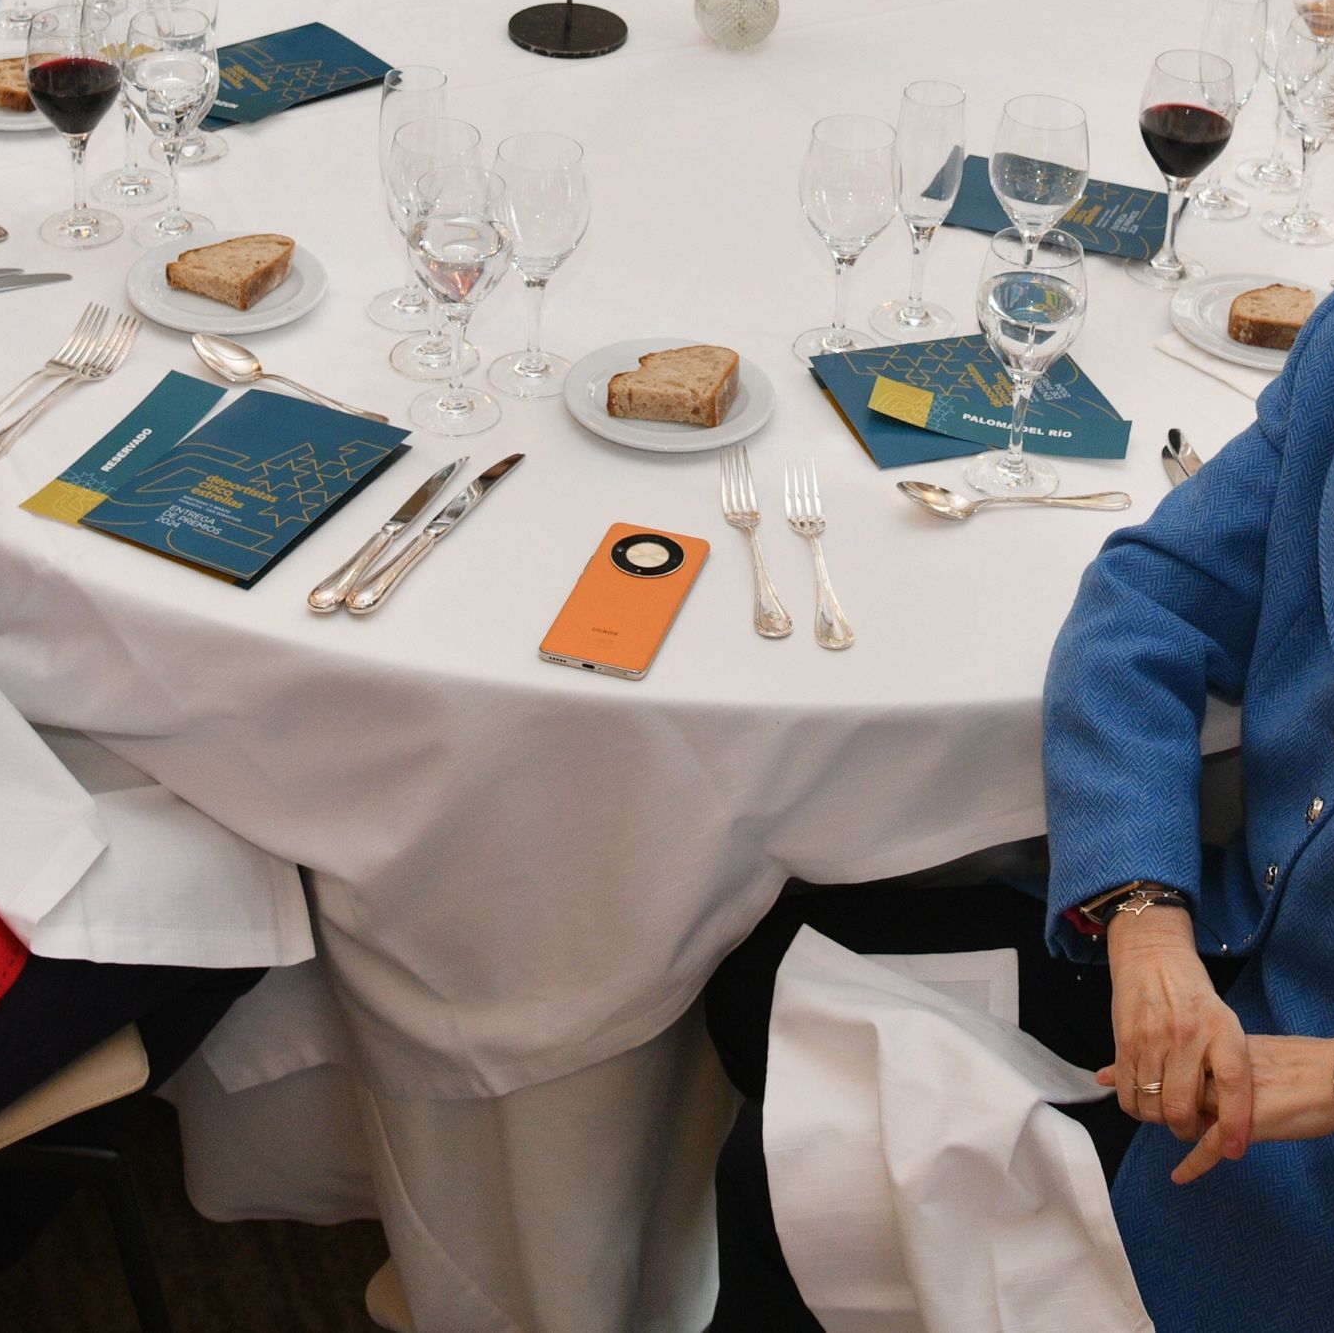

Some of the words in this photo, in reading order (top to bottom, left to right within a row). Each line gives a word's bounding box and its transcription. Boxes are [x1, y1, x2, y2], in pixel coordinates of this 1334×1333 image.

[962, 413, 1013, 430] PALOMA
[1021, 426, 1045, 436] DEL
[1048, 429, 1073, 438] RÍO
[100, 427, 153, 473] RESERVADO
[191, 487, 245, 510] estrellas
[198, 481, 234, 497] cinco
[205, 474, 279, 504] deportistas
[155, 517, 181, 529] 2024
[162, 510, 179, 522] DE
[179, 516, 223, 536] PREMIOS
[169, 504, 216, 524] ENTREGA
